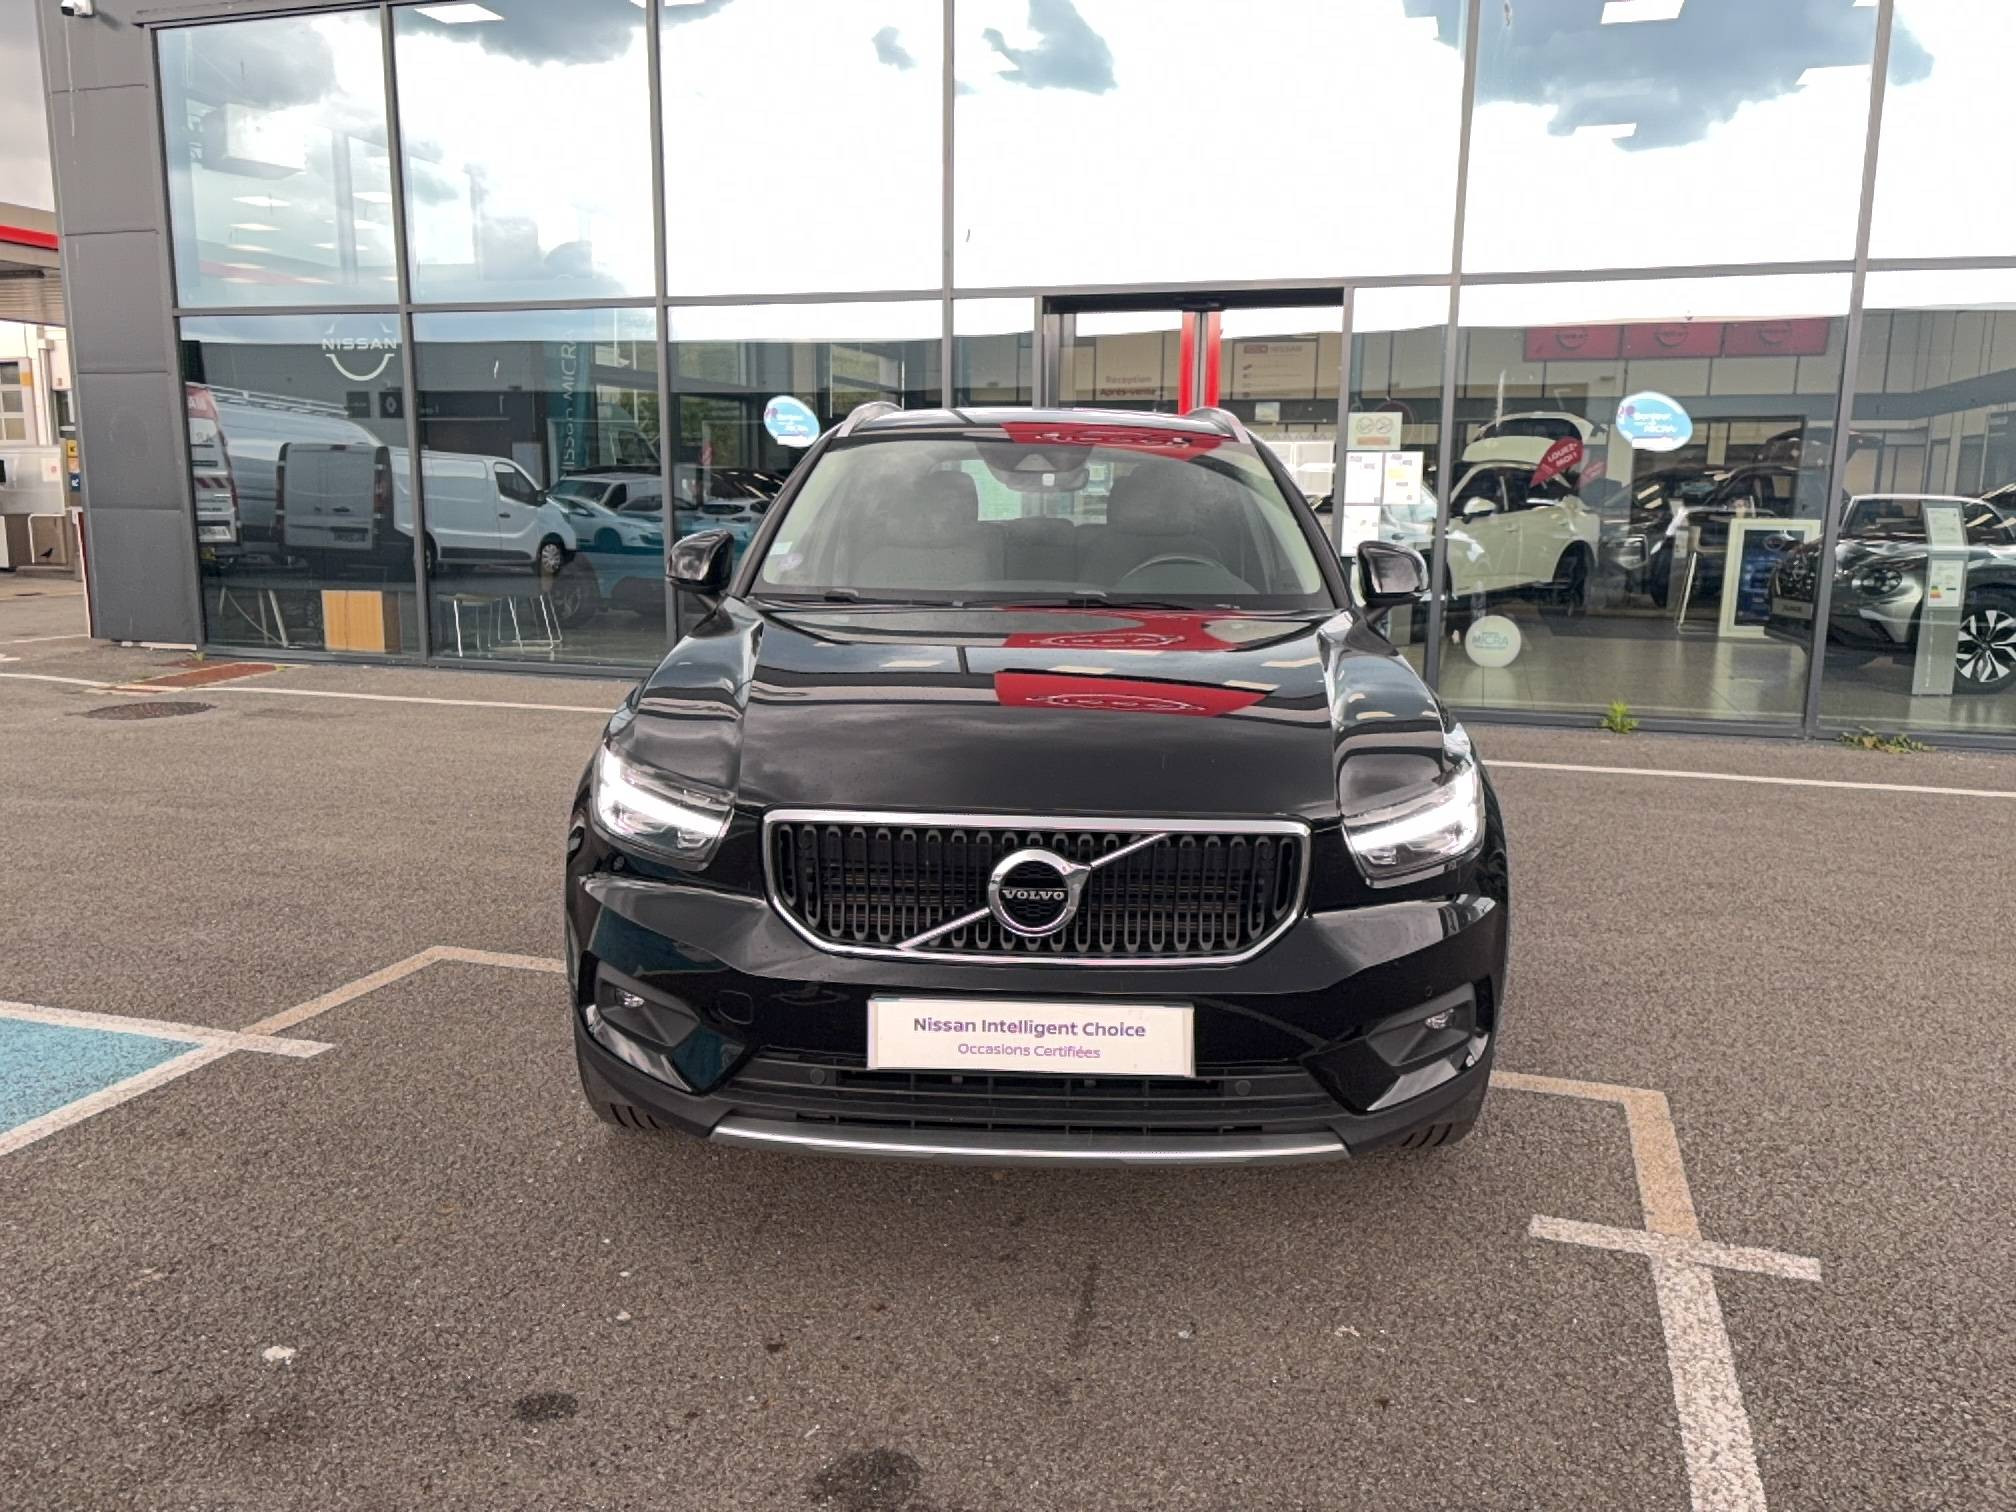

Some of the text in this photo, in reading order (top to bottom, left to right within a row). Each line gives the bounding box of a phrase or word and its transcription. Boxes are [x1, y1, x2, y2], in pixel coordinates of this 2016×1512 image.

[321, 338, 397, 350] NISSAN
[1001, 889, 1065, 901] VOLVO
[913, 1017, 1147, 1039] Nissan Intelligent Choice
[957, 1042, 1101, 1059] Occasions Certifiées
